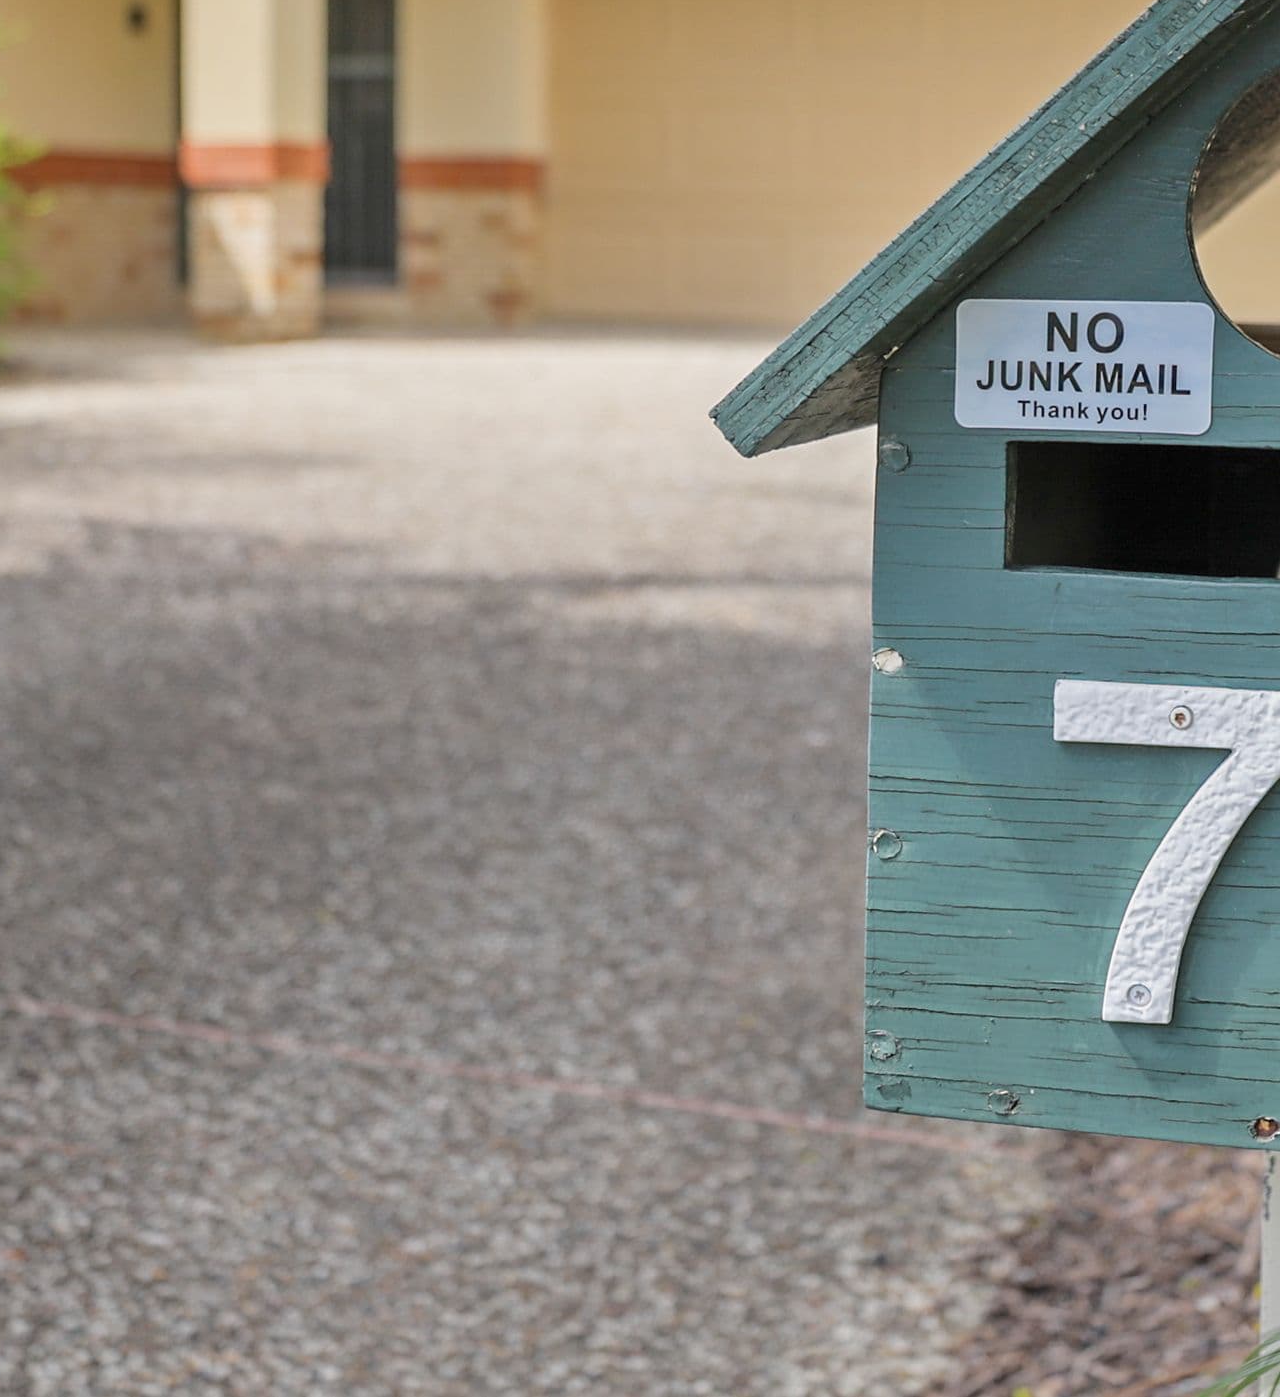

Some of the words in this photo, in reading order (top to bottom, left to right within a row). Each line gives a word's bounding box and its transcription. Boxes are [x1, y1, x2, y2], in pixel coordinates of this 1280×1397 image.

[1046, 312, 1124, 353] NO
[976, 360, 1083, 392] JUNK
[1095, 363, 1191, 395] MAIL
[1018, 400, 1089, 419] Thank
[1096, 404, 1148, 424] you!
